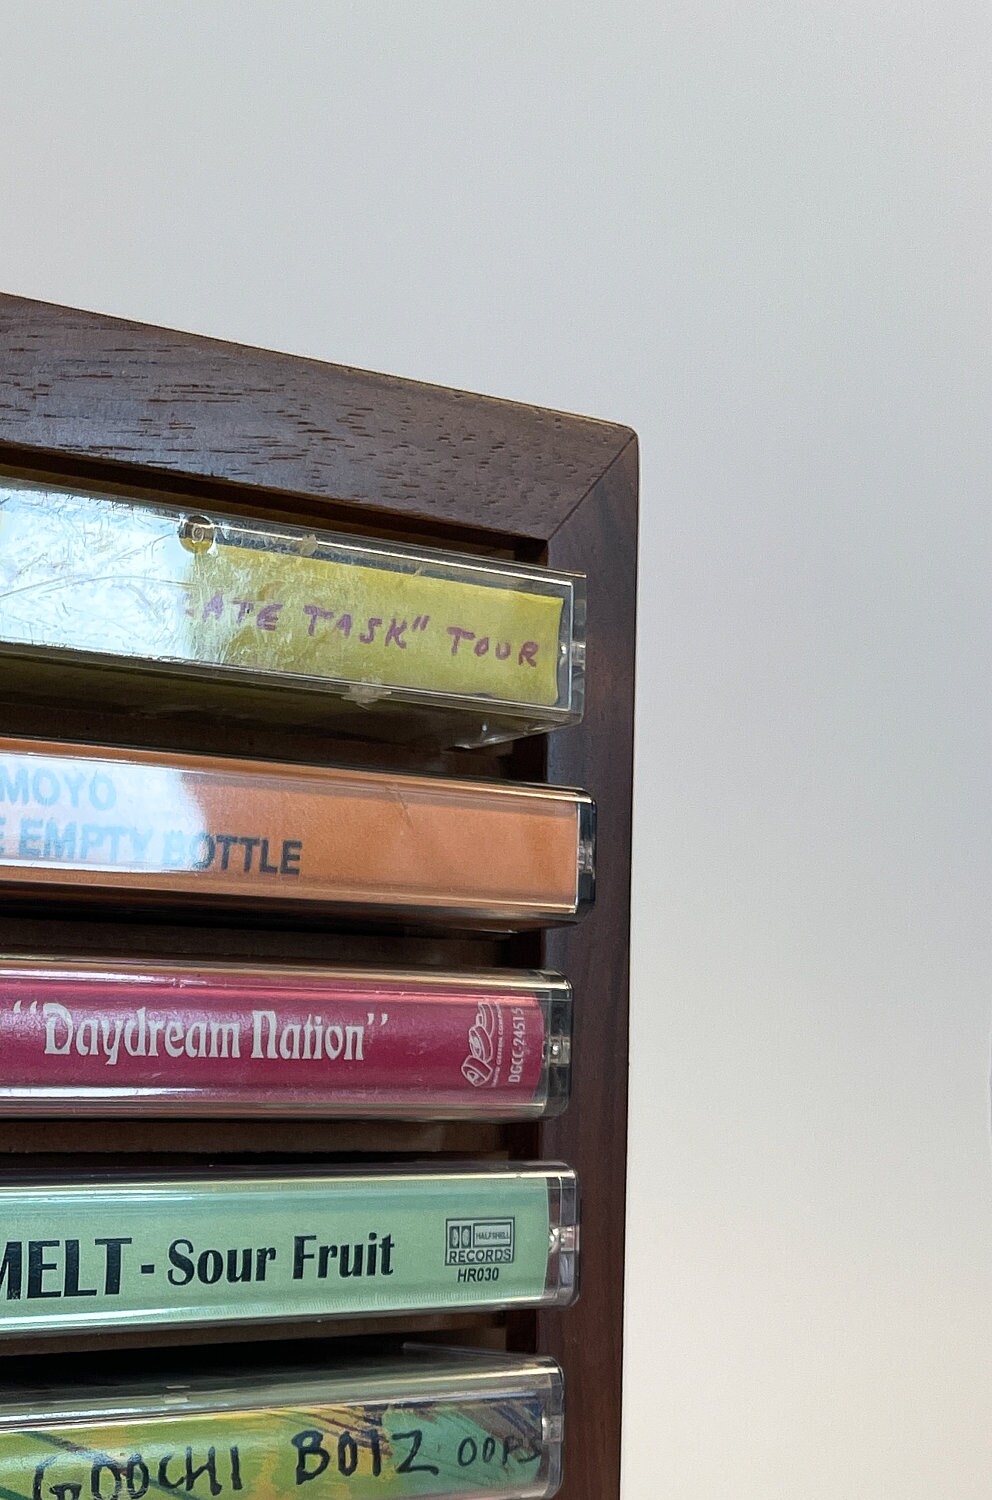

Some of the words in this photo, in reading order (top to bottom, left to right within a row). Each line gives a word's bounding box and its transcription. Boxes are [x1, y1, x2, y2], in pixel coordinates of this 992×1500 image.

[182, 592, 283, 632] ATE
[446, 625, 539, 668] TOUR
[18, 816, 154, 863] EMPTY
[160, 829, 303, 876] BOTTLE
[508, 1006, 526, 1083] DGCC-24515
[167, 1238, 276, 1287] Sour
[292, 1232, 395, 1280] Fruit
[449, 1248, 512, 1264] RECORDS
[456, 1267, 500, 1283] HR030
